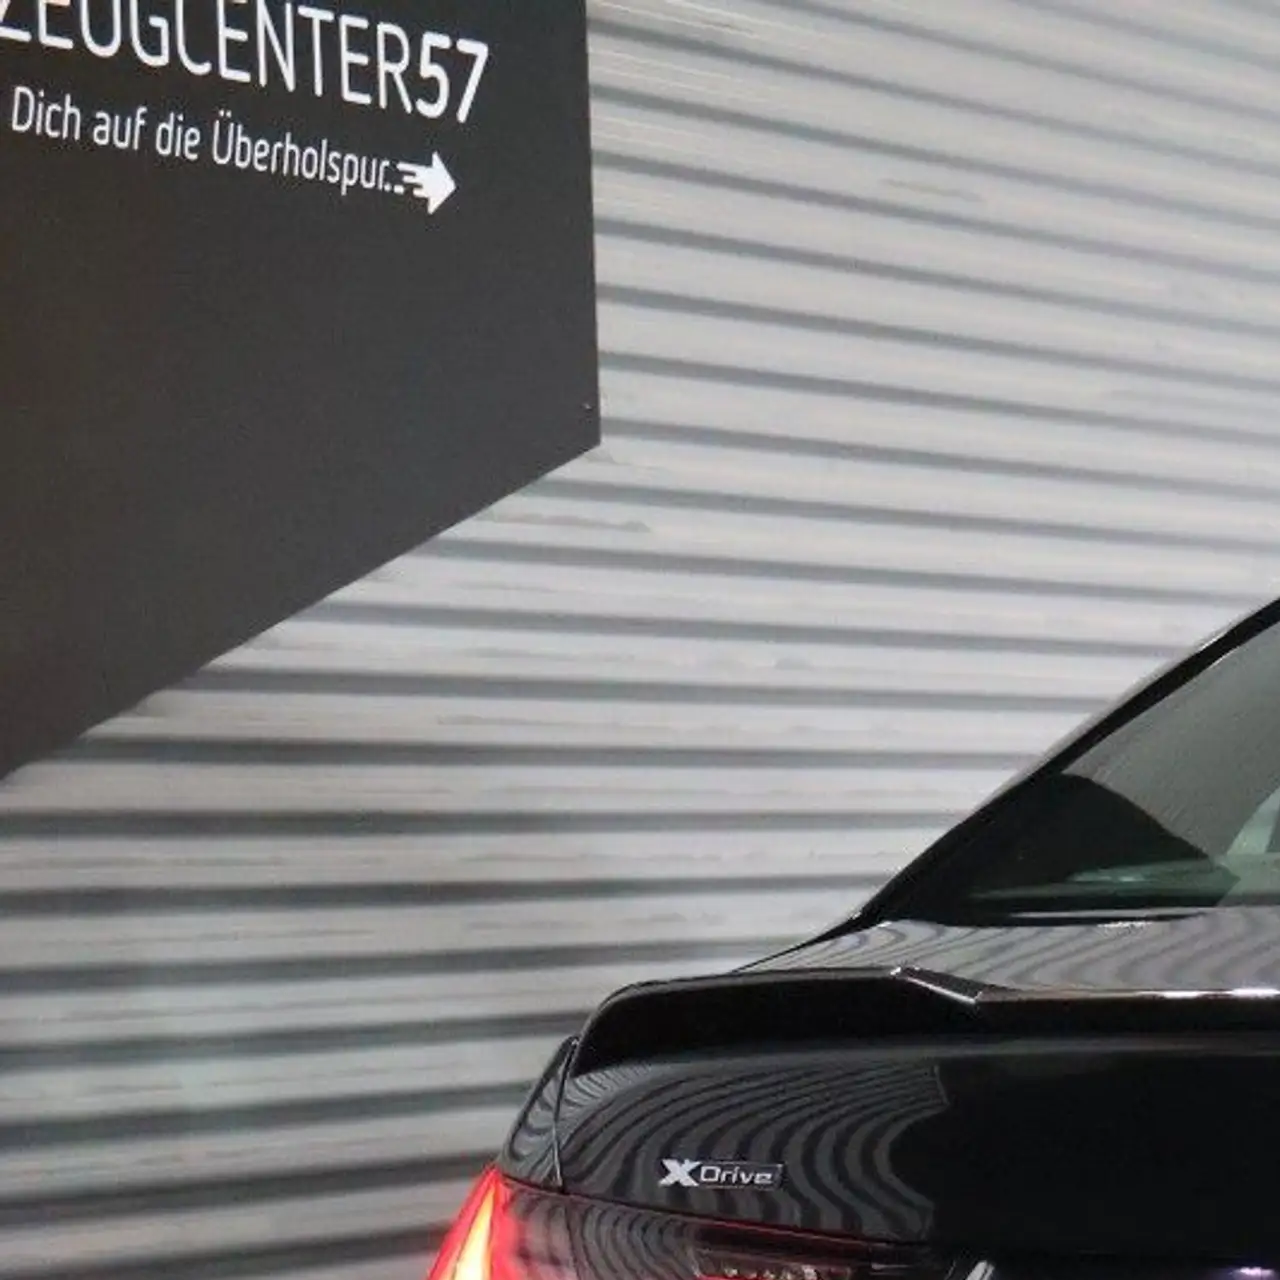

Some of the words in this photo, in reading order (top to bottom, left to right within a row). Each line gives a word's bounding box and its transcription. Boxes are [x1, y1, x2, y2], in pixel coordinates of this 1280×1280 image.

[12, 86, 82, 141] Dich
[92, 105, 148, 151] auf
[155, 112, 201, 161] die
